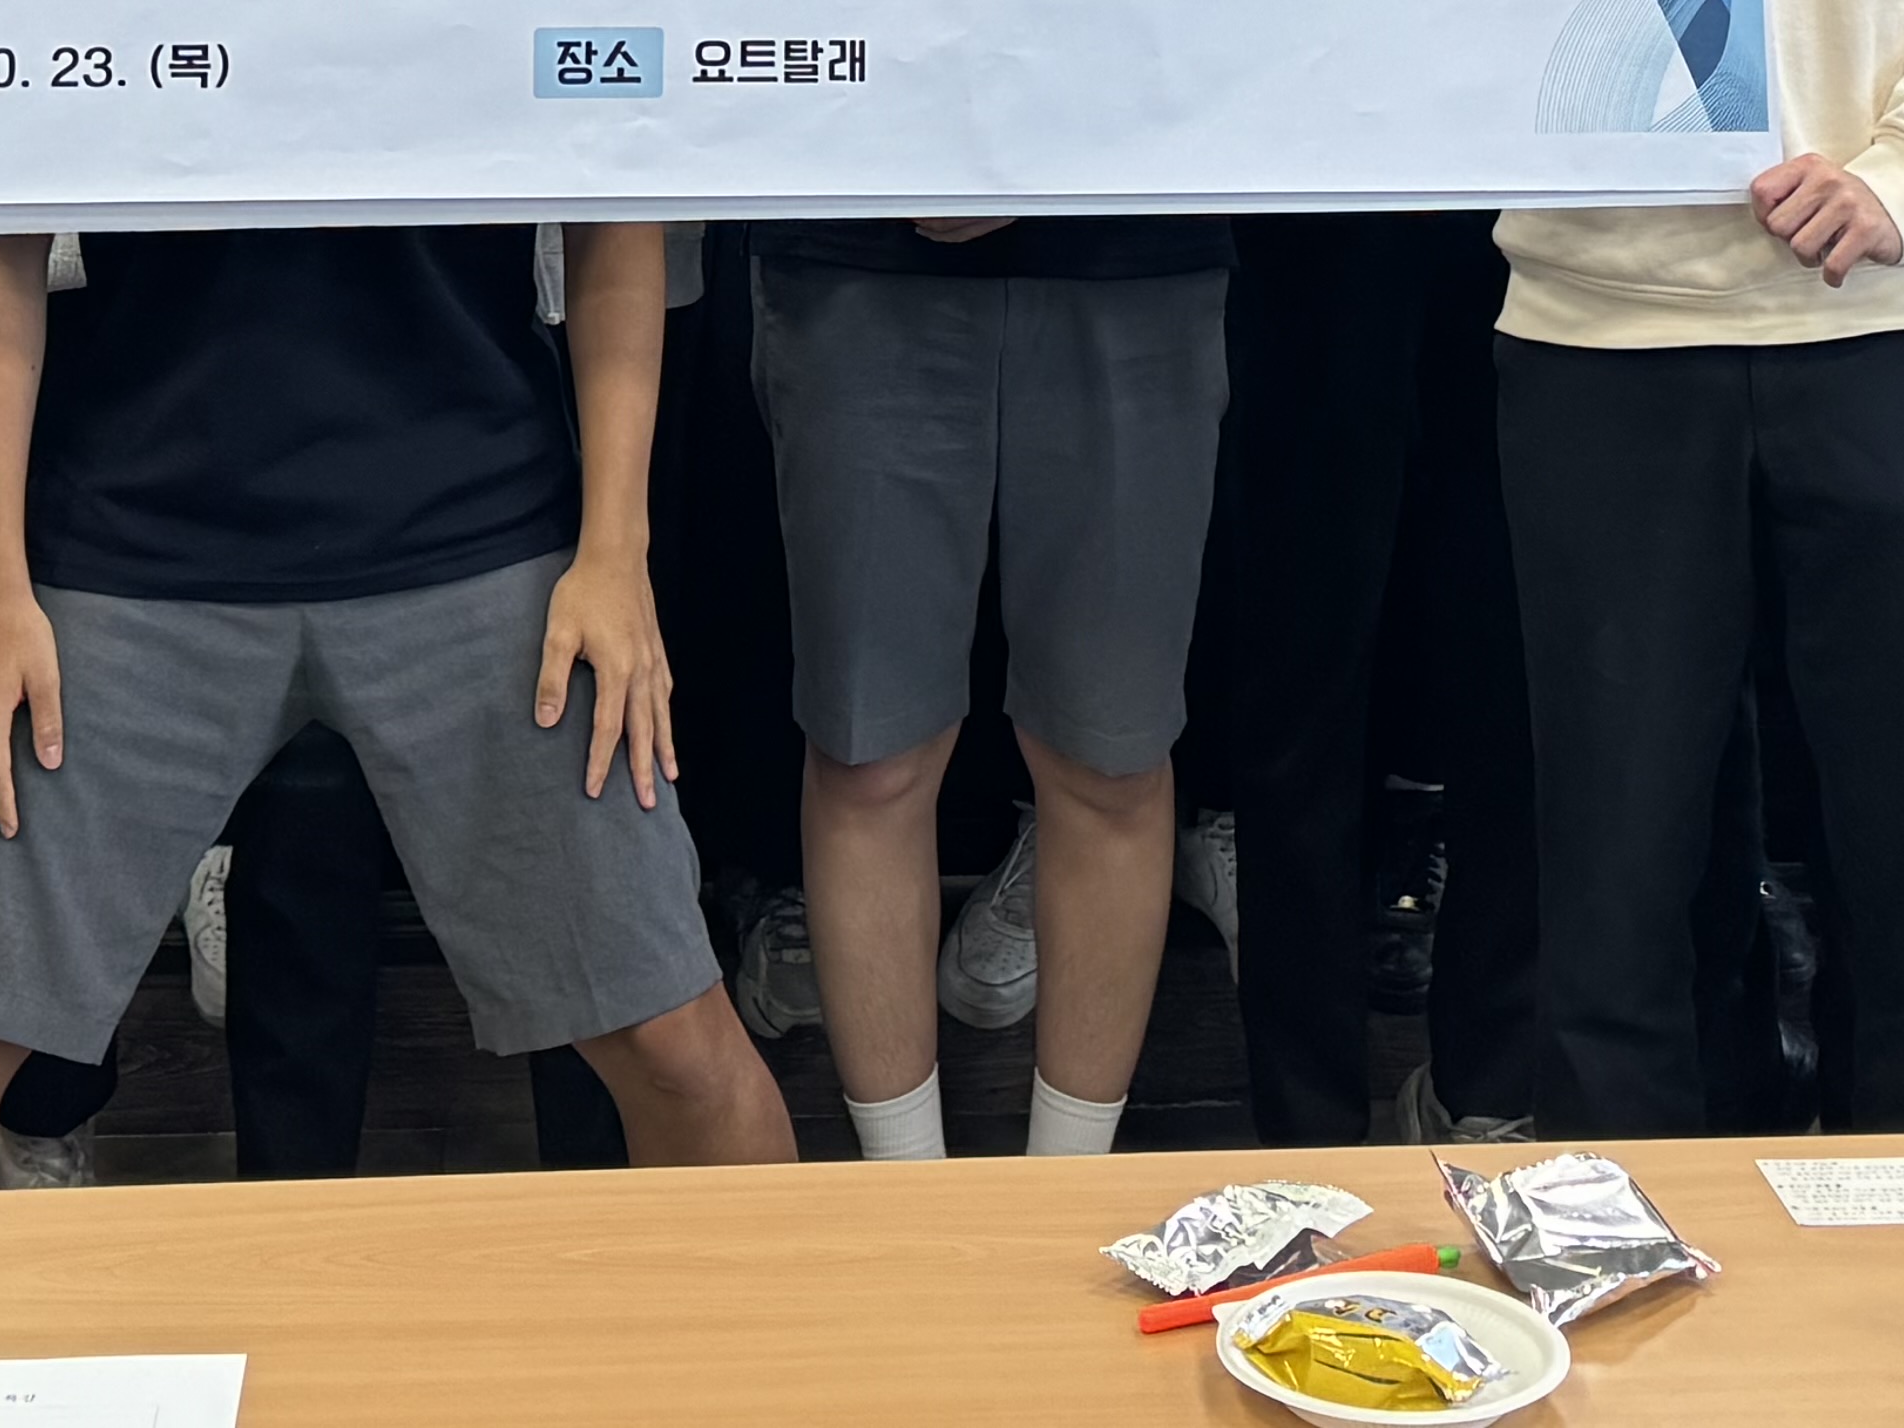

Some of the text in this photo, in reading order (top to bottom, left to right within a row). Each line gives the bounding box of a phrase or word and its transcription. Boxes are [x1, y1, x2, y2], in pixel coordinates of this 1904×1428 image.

[50, 46, 129, 91] 23.
[148, 43, 231, 91] (목)
[555, 39, 642, 86] 장소
[692, 38, 869, 86] 요트탈래
